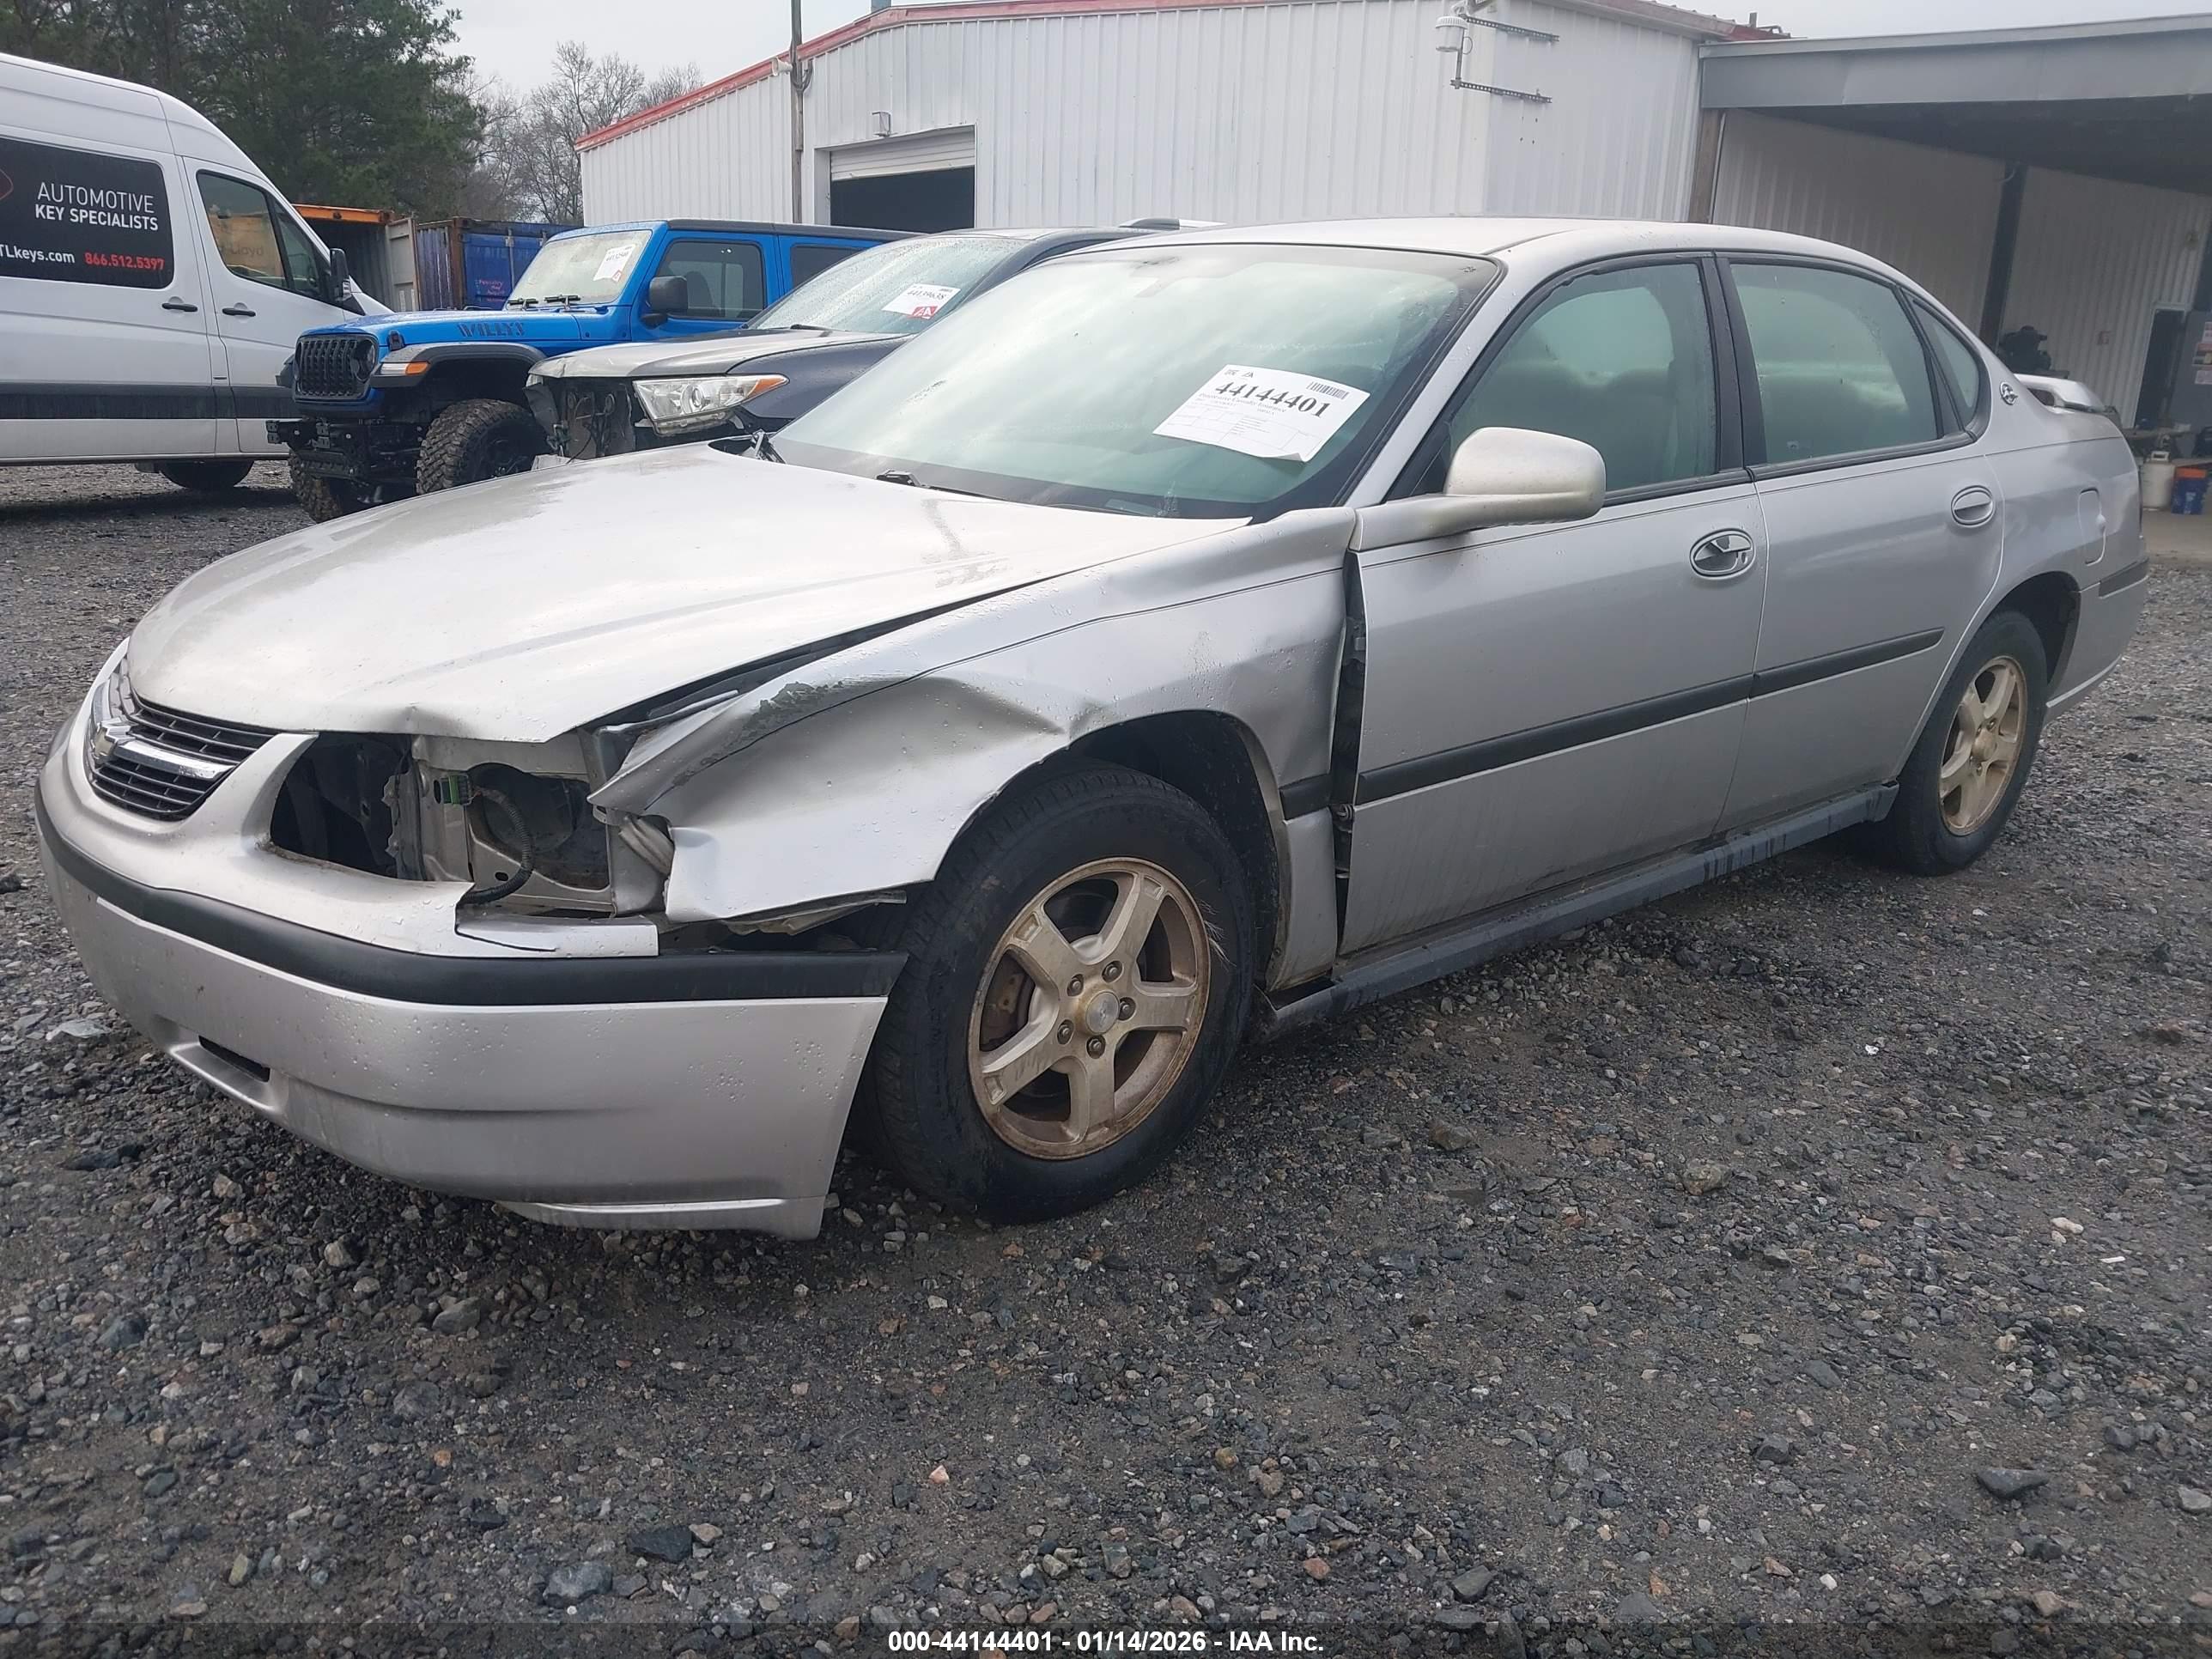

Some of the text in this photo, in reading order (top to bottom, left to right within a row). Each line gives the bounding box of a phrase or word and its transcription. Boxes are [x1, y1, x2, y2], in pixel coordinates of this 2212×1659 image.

[38, 182, 155, 214] AUTOMOTIVE
[35, 204, 159, 231] KEY SPECIALISTS
[84, 252, 165, 270] 866.512.5397
[457, 321, 525, 337] WILLYS
[1215, 381, 1331, 418] 44144401
